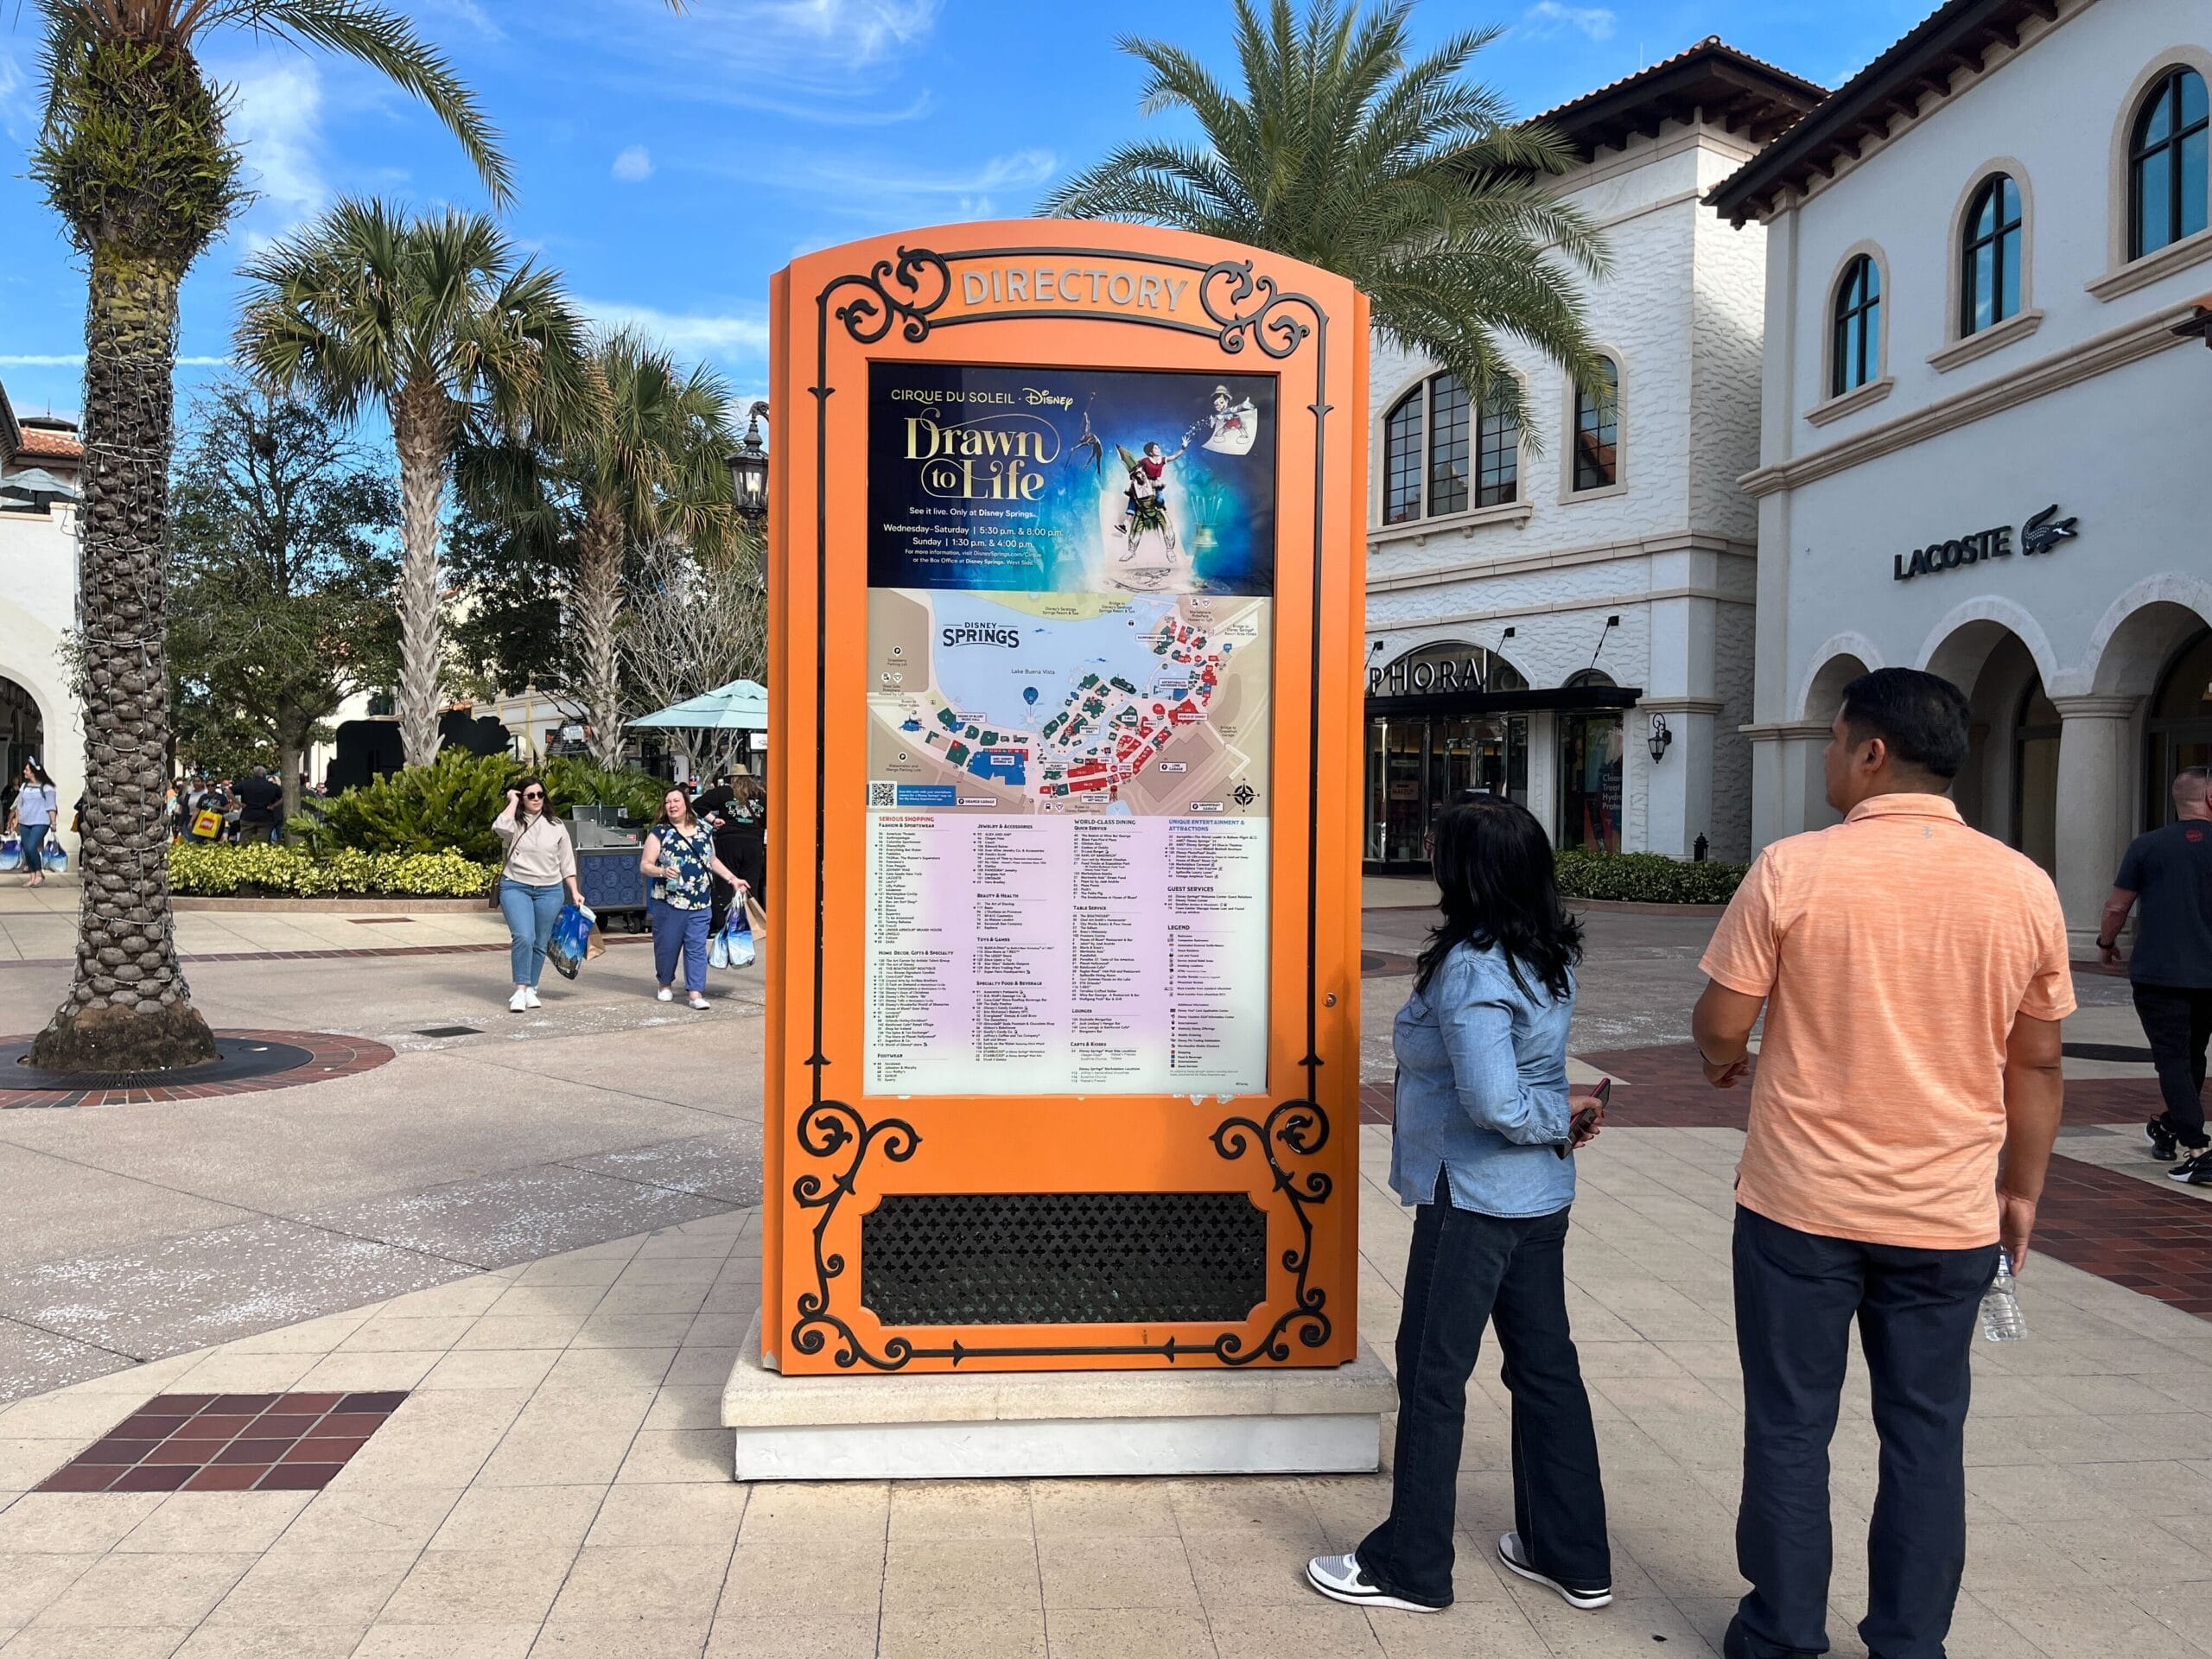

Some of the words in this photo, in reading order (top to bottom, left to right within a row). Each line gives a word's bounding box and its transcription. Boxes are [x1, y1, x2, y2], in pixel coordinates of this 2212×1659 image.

[962, 268, 1188, 311] DIRECTORY
[891, 389, 942, 404] CIRQUE
[946, 391, 965, 402] DU
[969, 392, 1015, 404] SOLEIL
[904, 408, 1060, 464] Drawn
[931, 468, 956, 488] to
[959, 459, 1045, 500] Life
[950, 508, 967, 517] Only
[979, 509, 1004, 518] Disney
[912, 537, 942, 546] Sunday
[1894, 525, 2012, 581] LACOSTE
[943, 628, 1019, 648] SPRINGS
[1370, 658, 1481, 693] PHORA
[1602, 792, 1622, 802] Hydr
